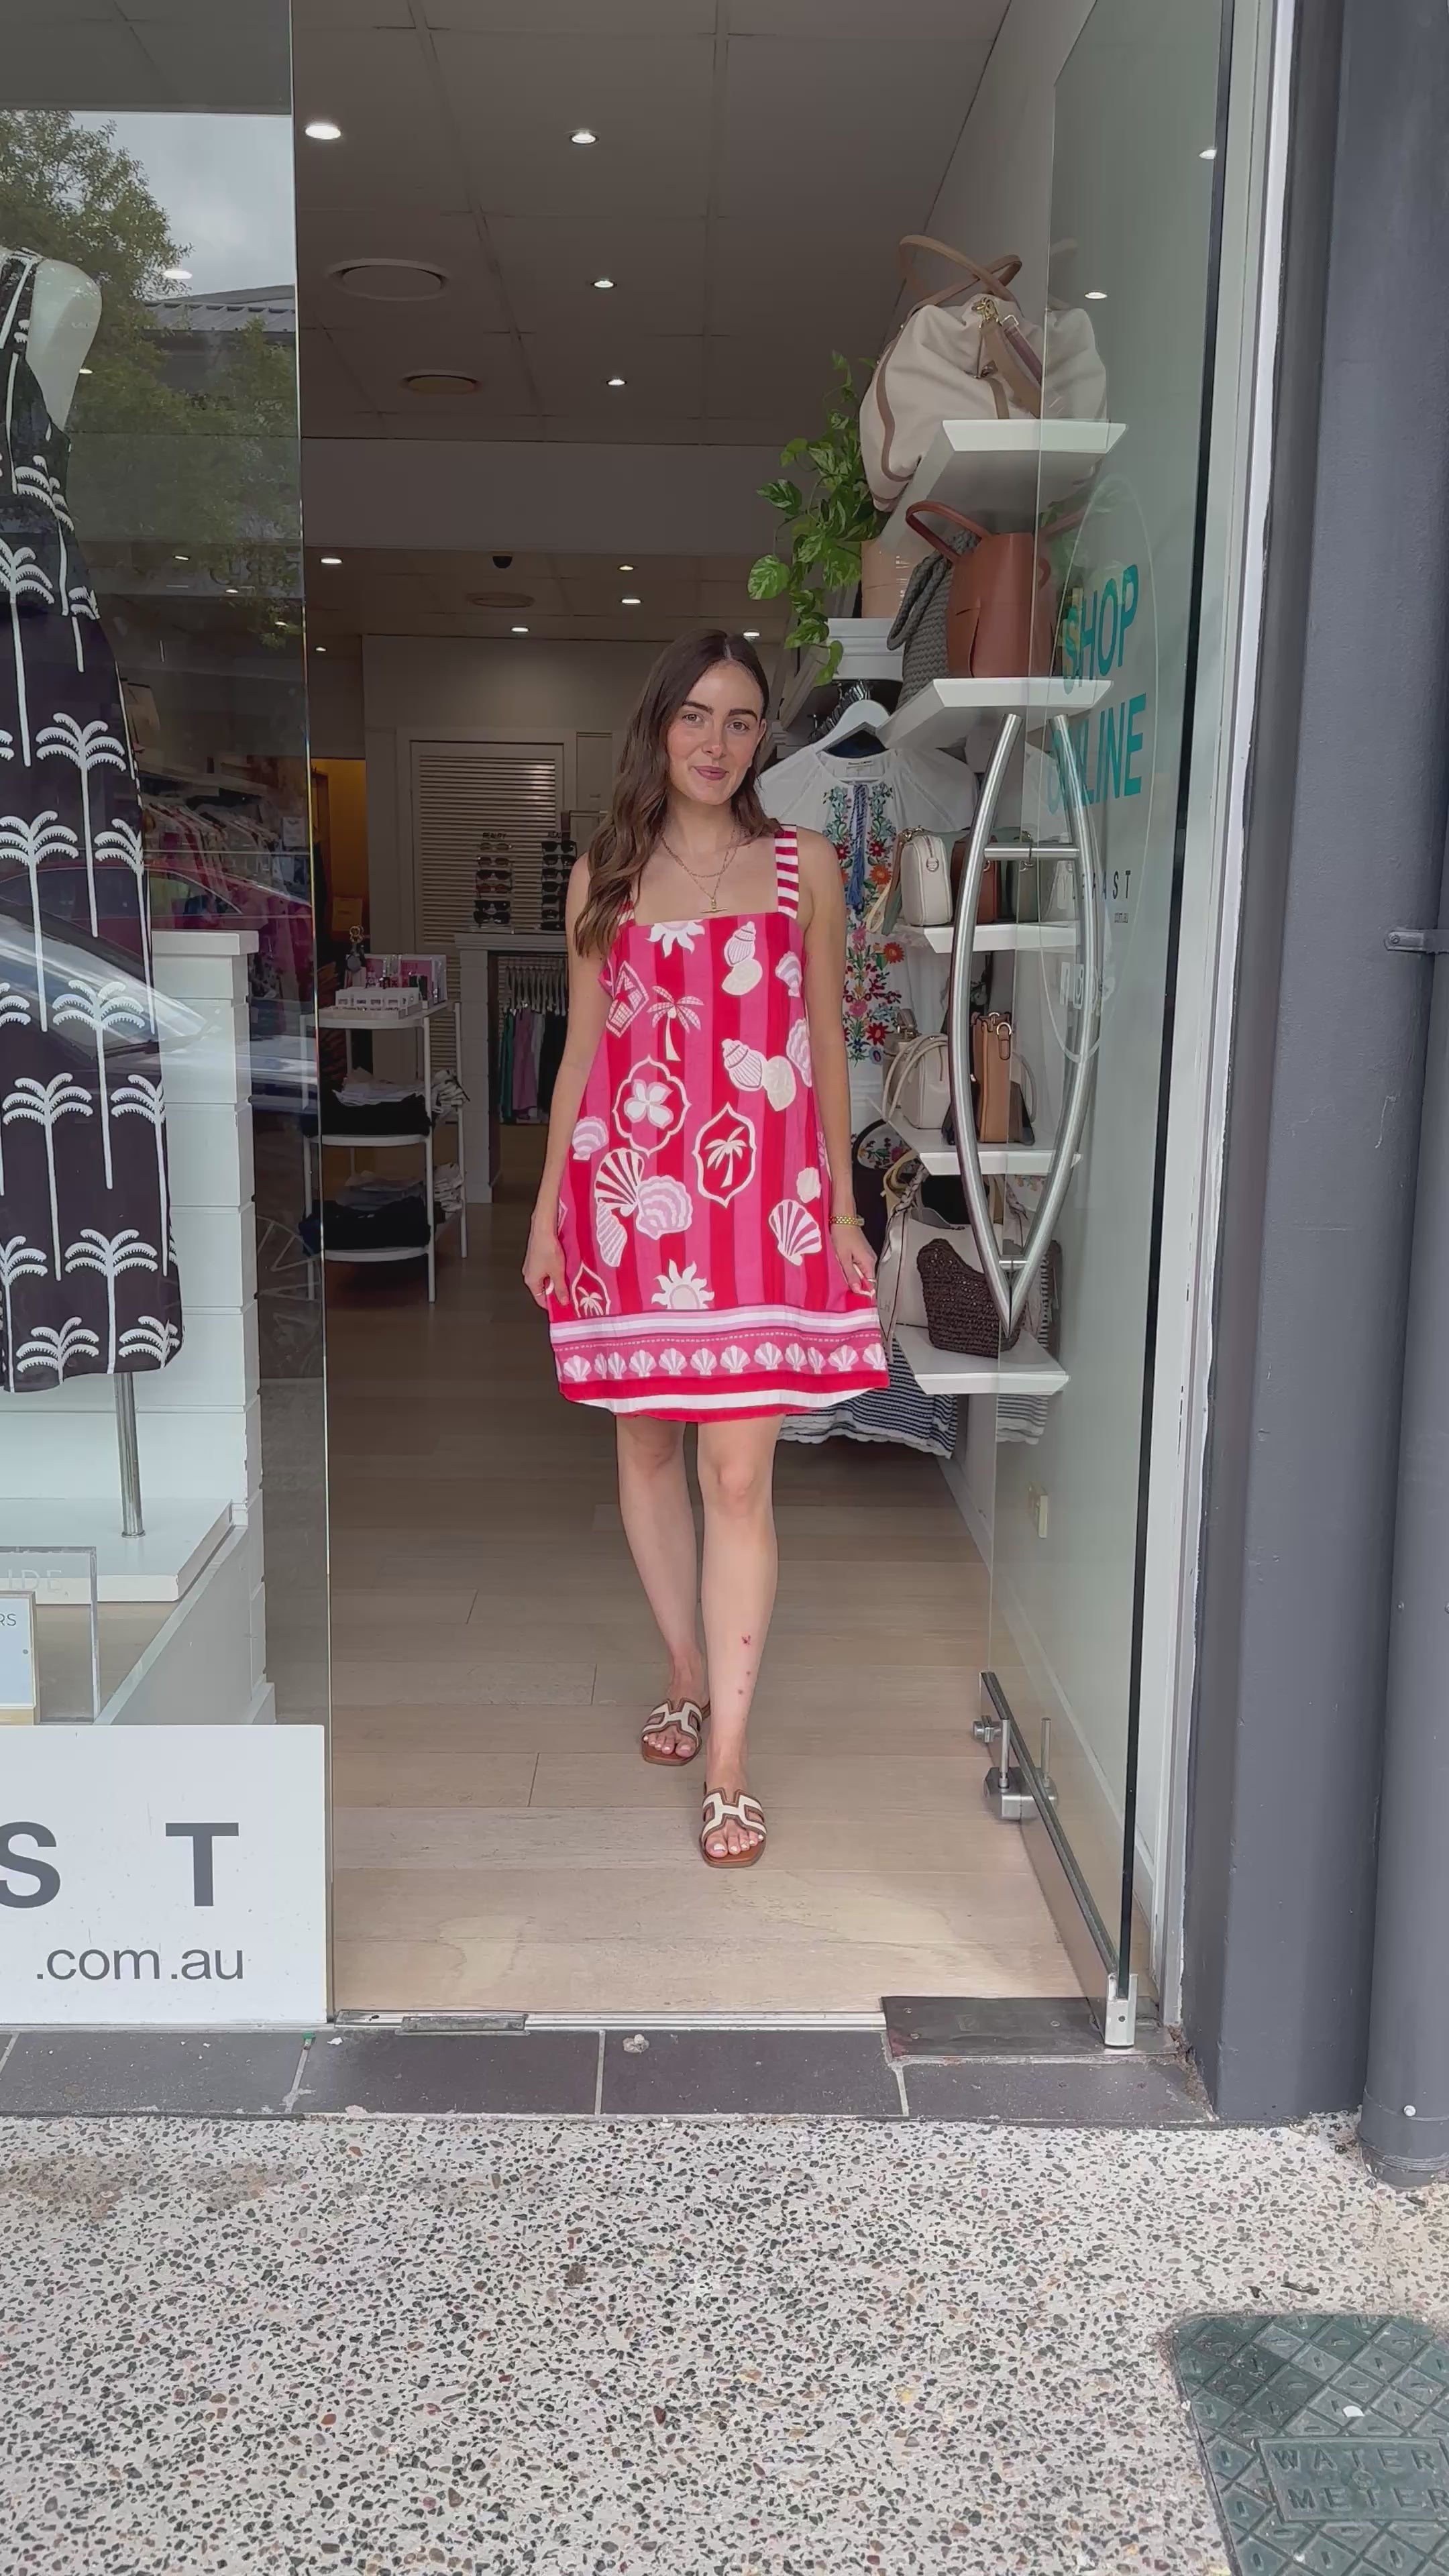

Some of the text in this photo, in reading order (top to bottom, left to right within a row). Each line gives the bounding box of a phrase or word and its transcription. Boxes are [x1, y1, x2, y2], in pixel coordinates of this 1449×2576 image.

[1062, 564, 1138, 695] SHOP
[36, 1949, 244, 1980] .com.au
[1271, 2449, 1437, 2474] WATER
[1287, 2487, 1449, 2511] METER
